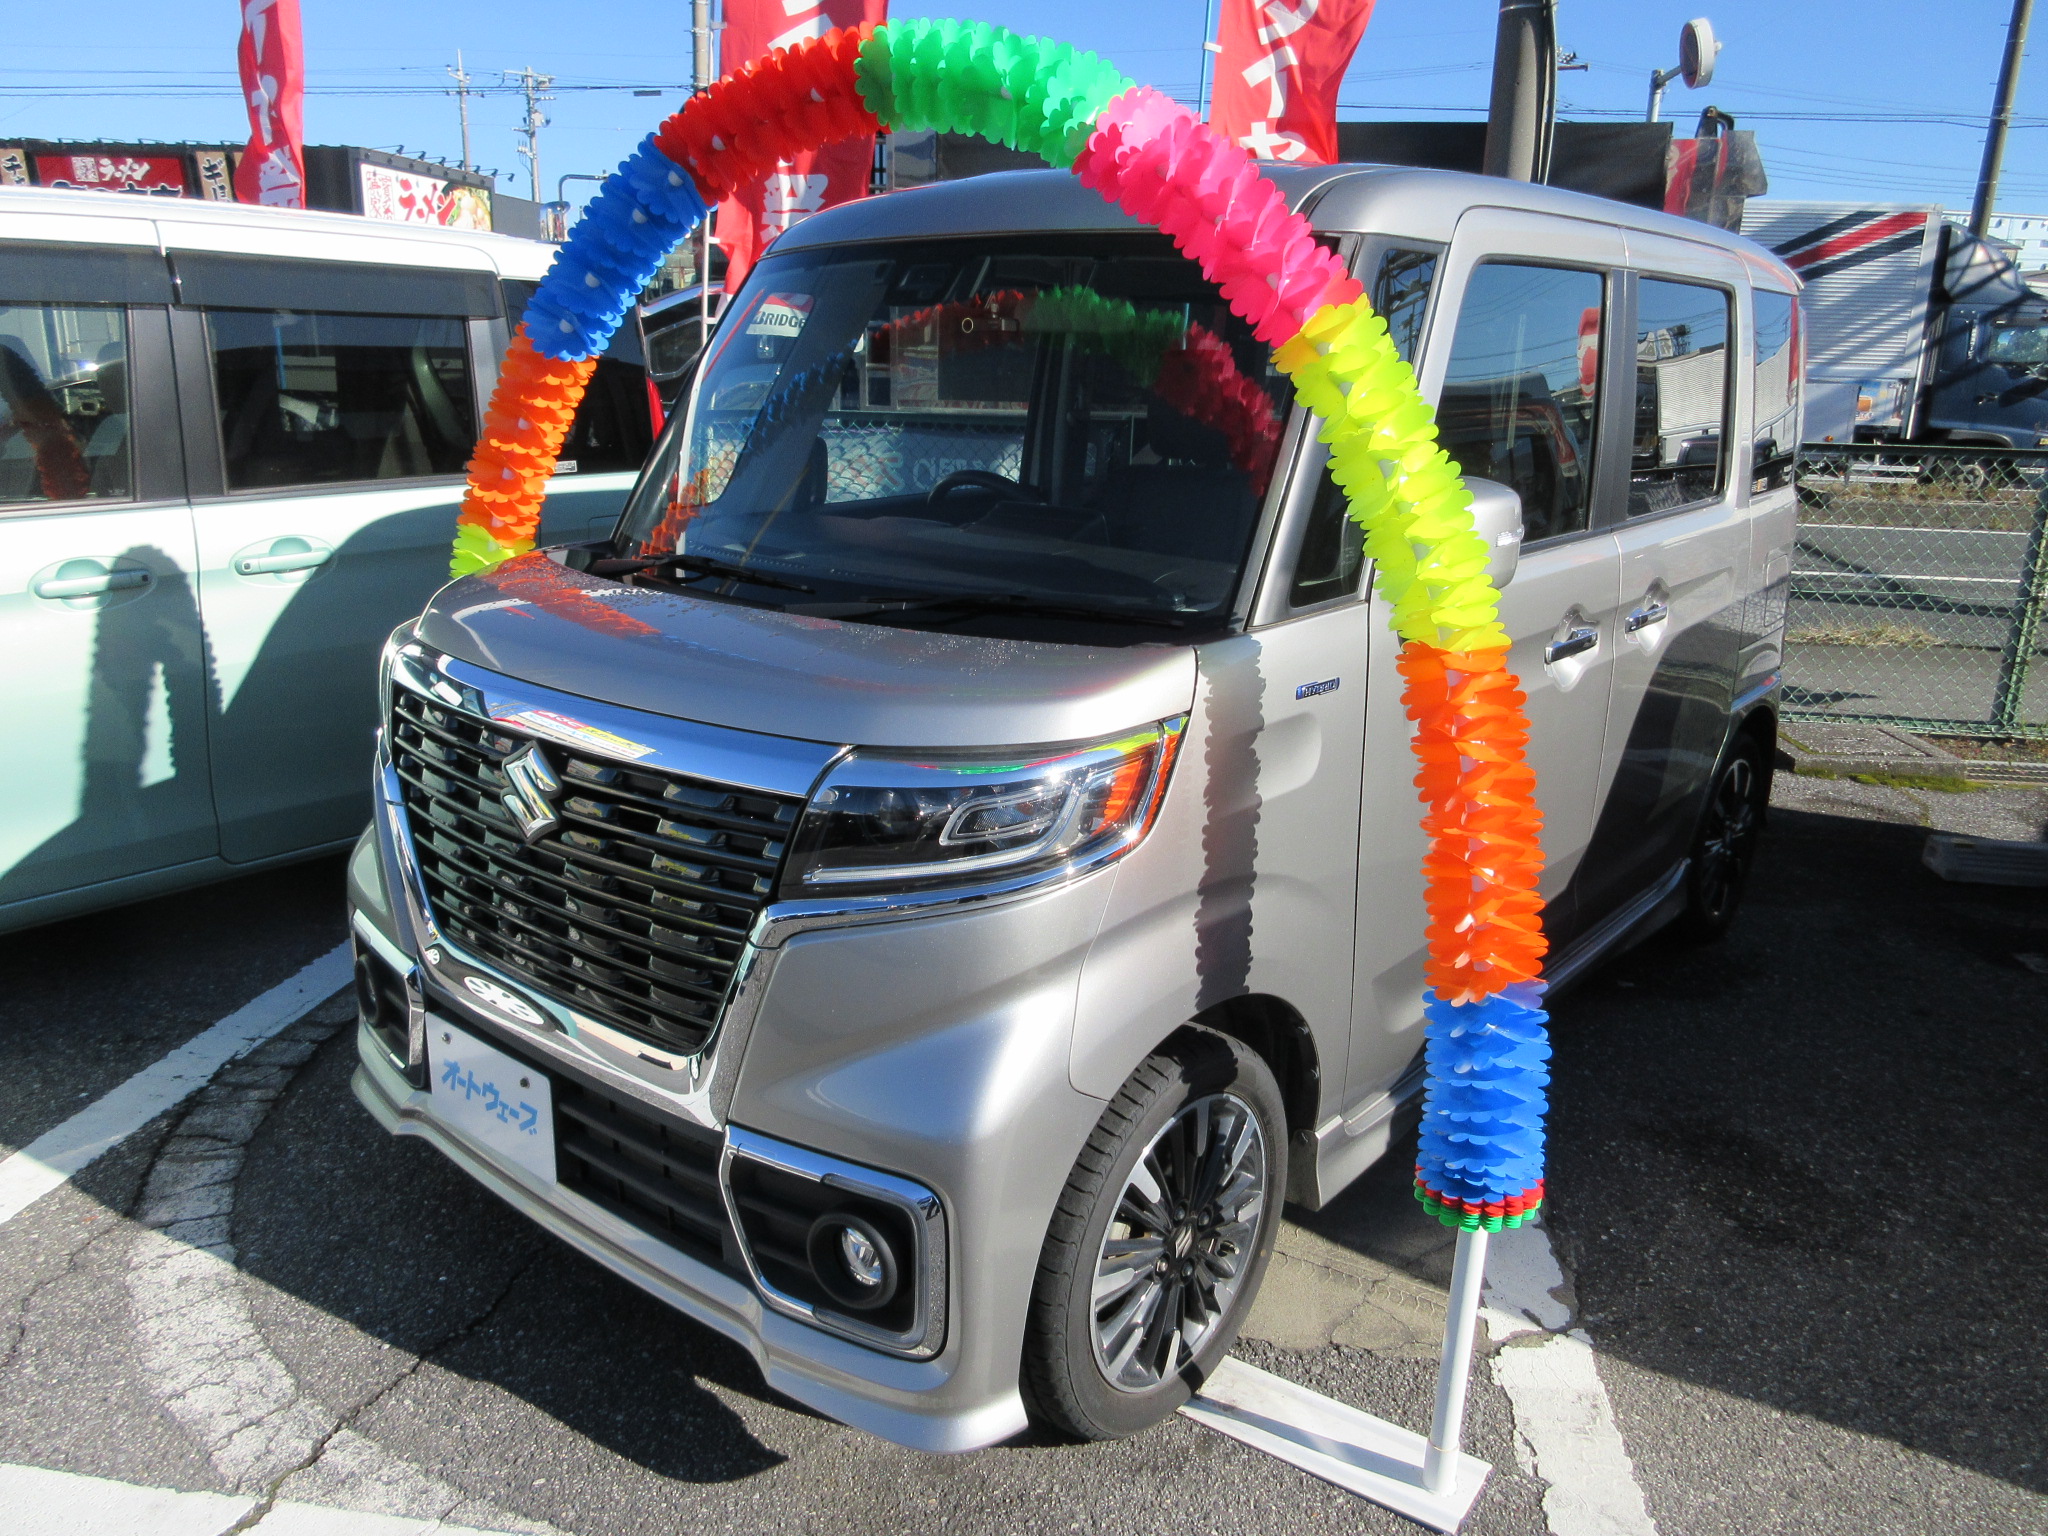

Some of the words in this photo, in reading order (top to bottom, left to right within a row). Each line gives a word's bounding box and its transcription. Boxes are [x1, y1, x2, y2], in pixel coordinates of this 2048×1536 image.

[99, 157, 150, 182] ラーメン
[398, 178, 457, 226] ラーメン
[441, 1060, 538, 1135] オートウェーブ
